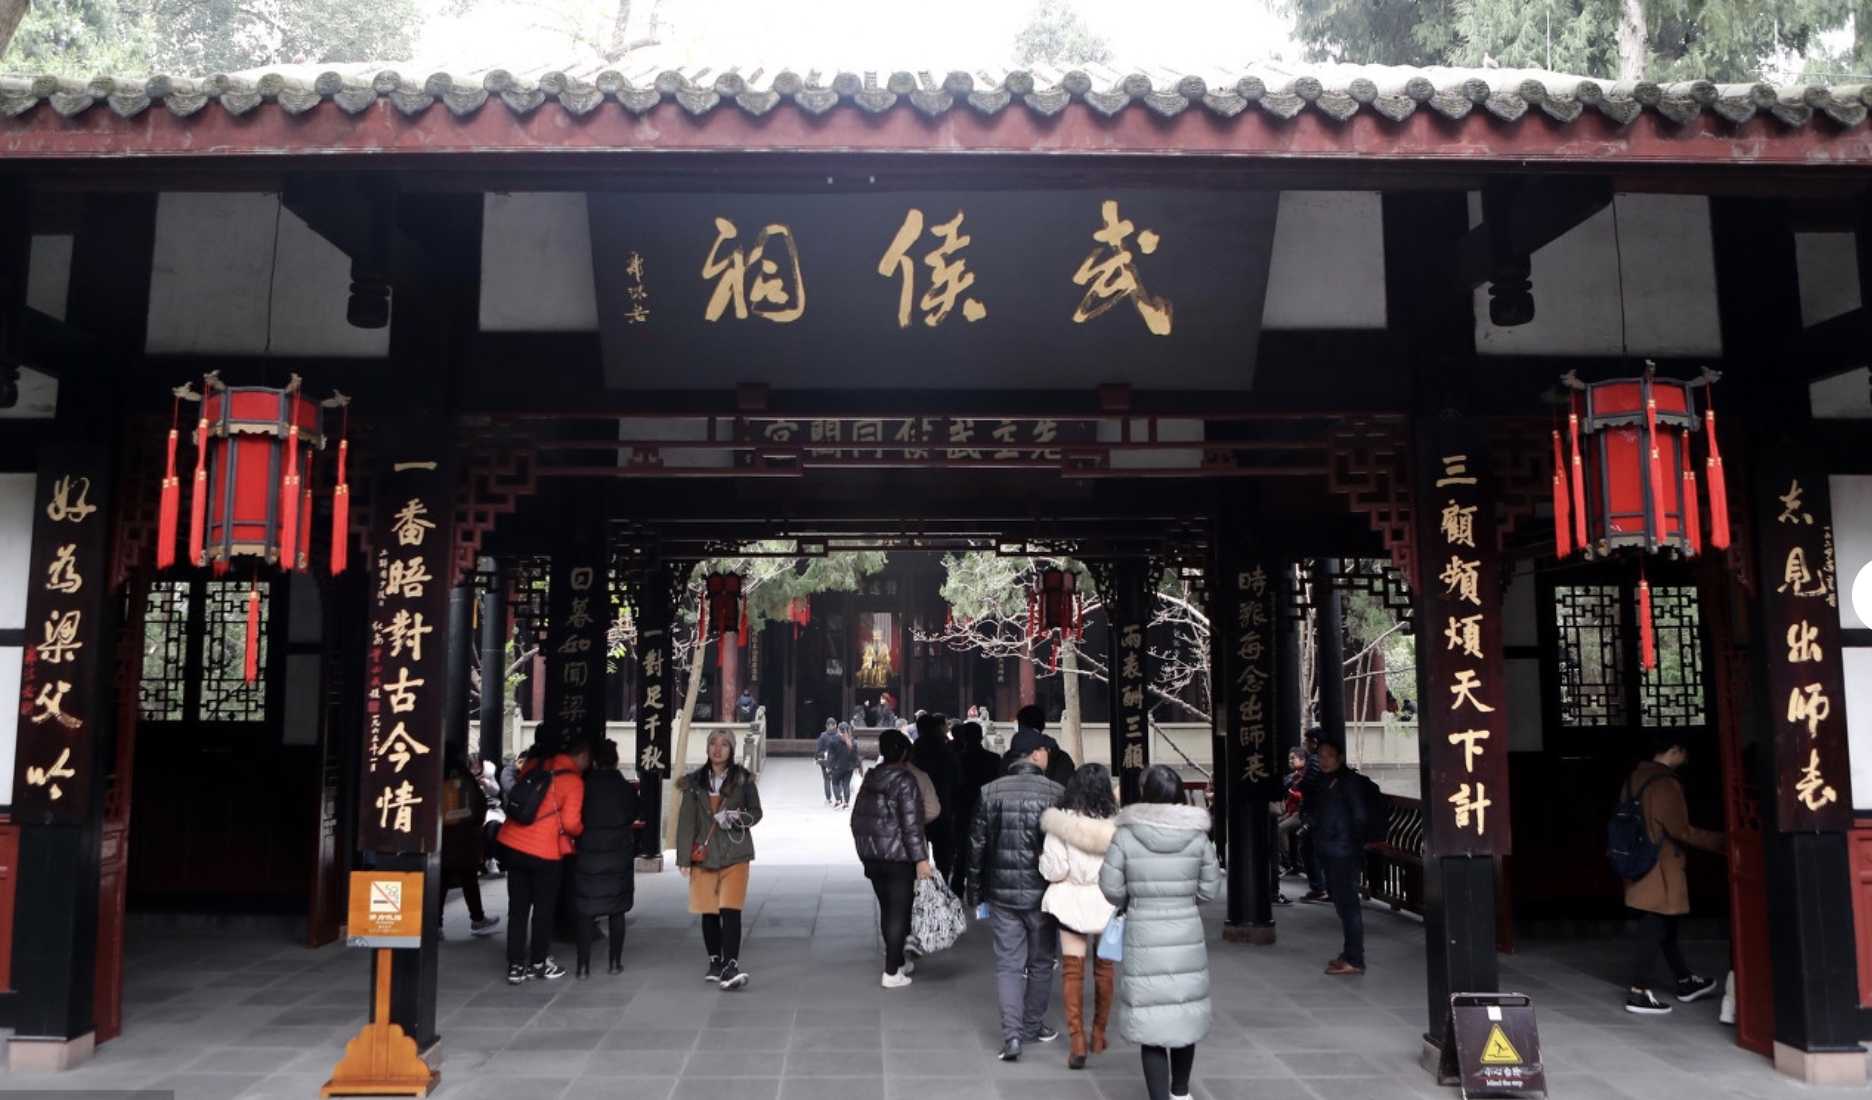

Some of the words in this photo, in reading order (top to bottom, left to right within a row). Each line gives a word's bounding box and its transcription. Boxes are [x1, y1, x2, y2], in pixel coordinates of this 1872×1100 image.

[703, 200, 1173, 336] 武侯祠
[376, 460, 438, 833] 一番晤對古今情
[642, 629, 665, 771] 一對足千秋
[1436, 455, 1495, 836] 三顧頻煩天下計
